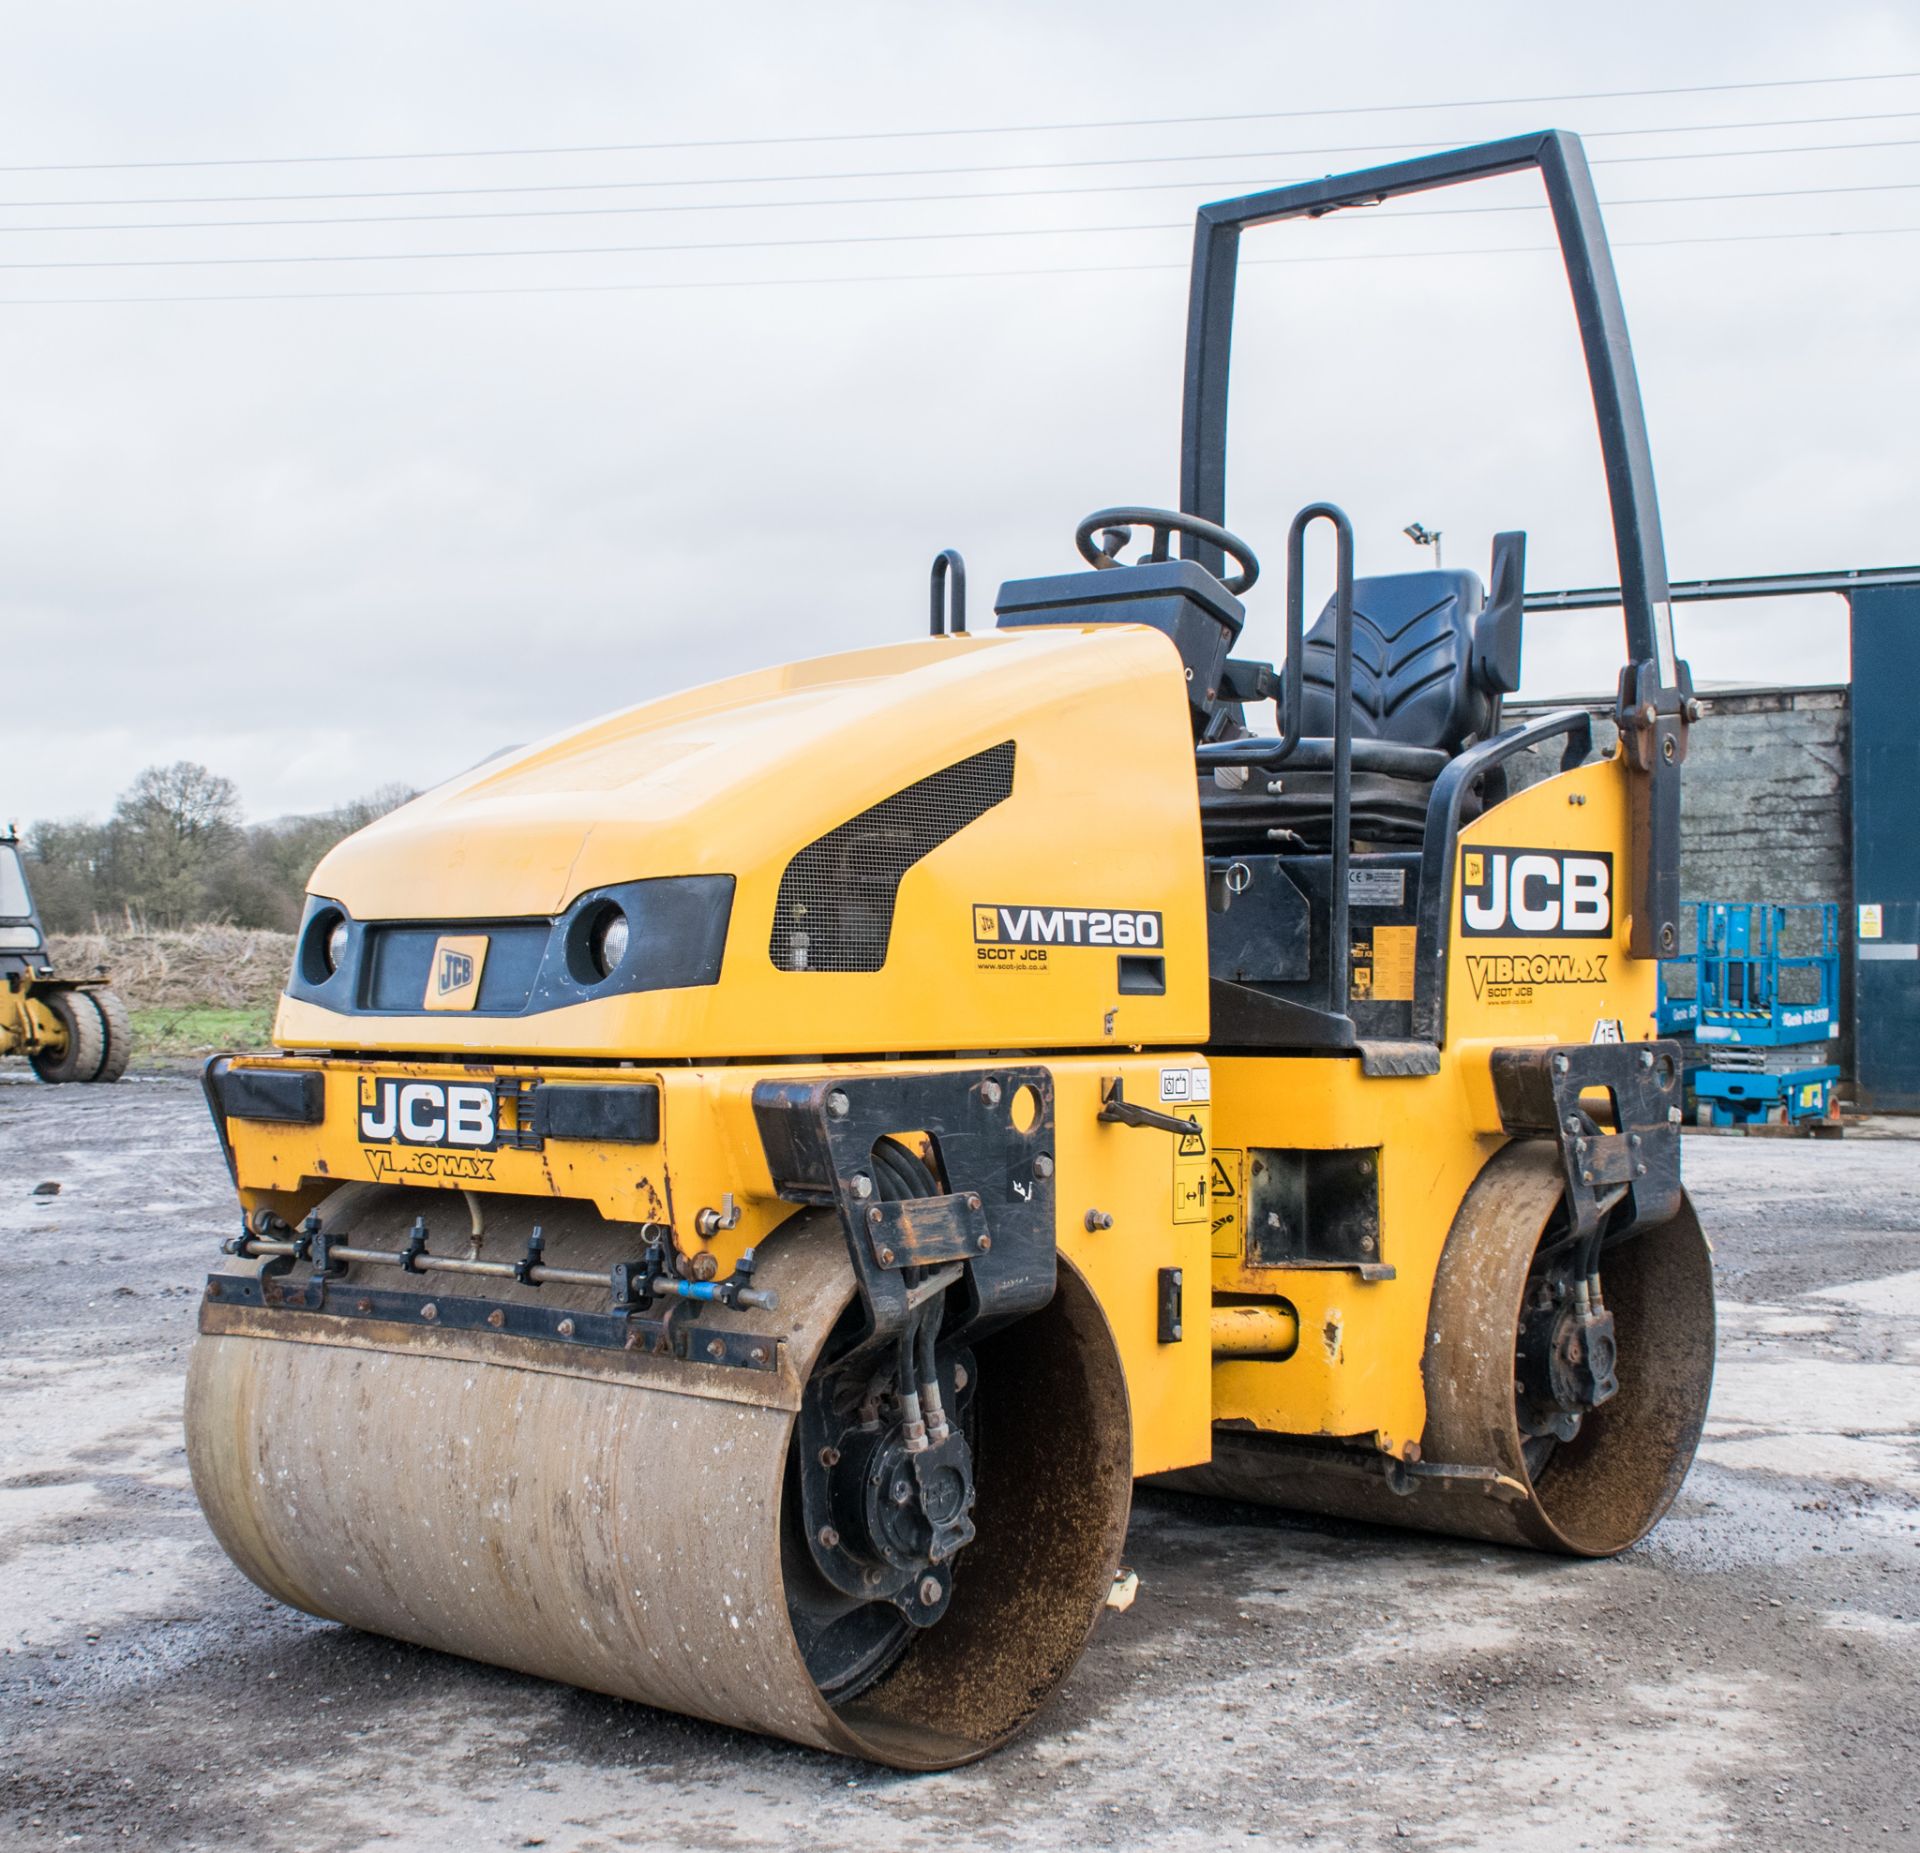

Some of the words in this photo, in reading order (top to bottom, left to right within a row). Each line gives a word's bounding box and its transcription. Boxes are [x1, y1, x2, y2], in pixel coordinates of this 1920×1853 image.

[1464, 855, 1610, 931] JCB
[999, 908, 1159, 945] VMT260
[441, 954, 471, 990] JCB
[977, 948, 1016, 960] SCOT
[1020, 949, 1048, 961] JCB
[977, 962, 1048, 971] www.scot-jcb.co.uk
[1465, 954, 1608, 1001] VIBROMAX
[1487, 987, 1513, 998] SCOT
[1515, 987, 1533, 997] JCB
[361, 1083, 495, 1143] JCB
[363, 1148, 496, 1182] VIROMAX
